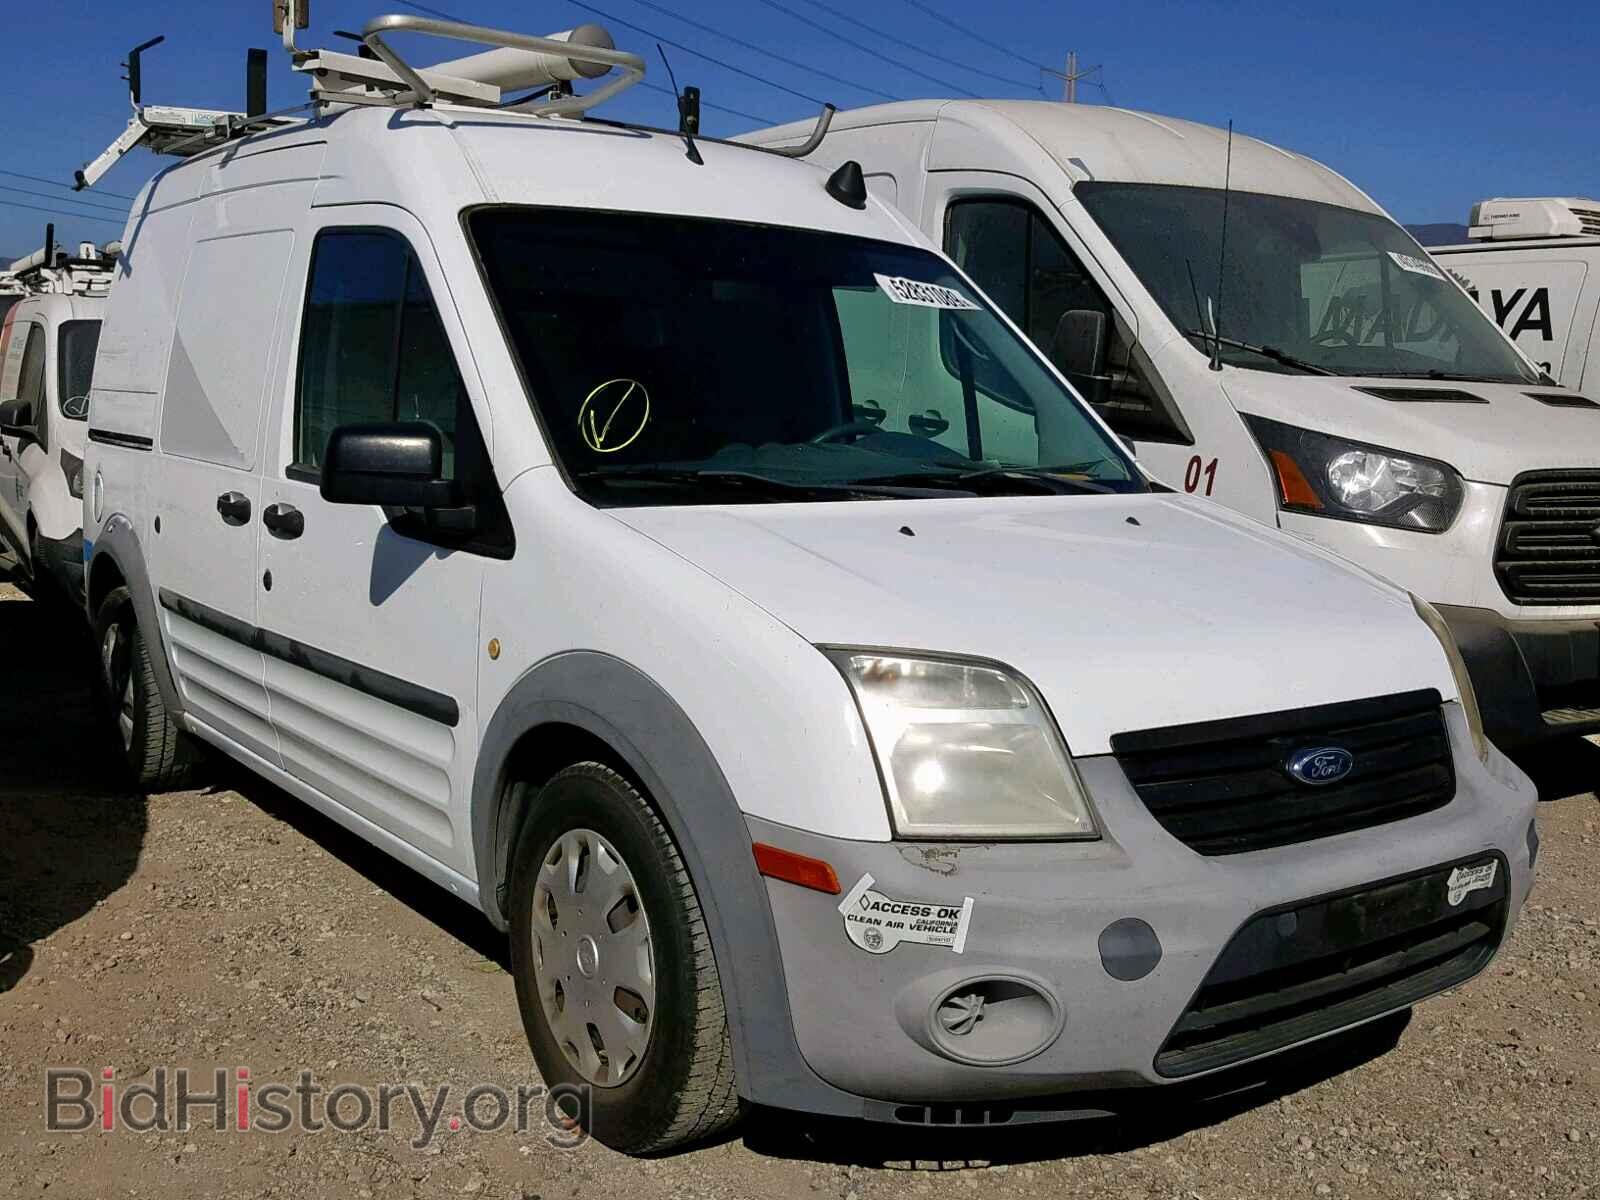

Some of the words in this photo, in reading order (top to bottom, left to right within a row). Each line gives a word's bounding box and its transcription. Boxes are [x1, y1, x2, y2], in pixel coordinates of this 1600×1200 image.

[1185, 455, 1218, 496] 01
[1312, 756, 1342, 778] Ford
[870, 902, 931, 918] ACCESS
[937, 908, 961, 919] OK
[847, 914, 882, 926] CLEAN
[886, 920, 904, 929] AIR
[910, 924, 957, 935] VEHICLE
[916, 919, 958, 927] CALIFORNIA
